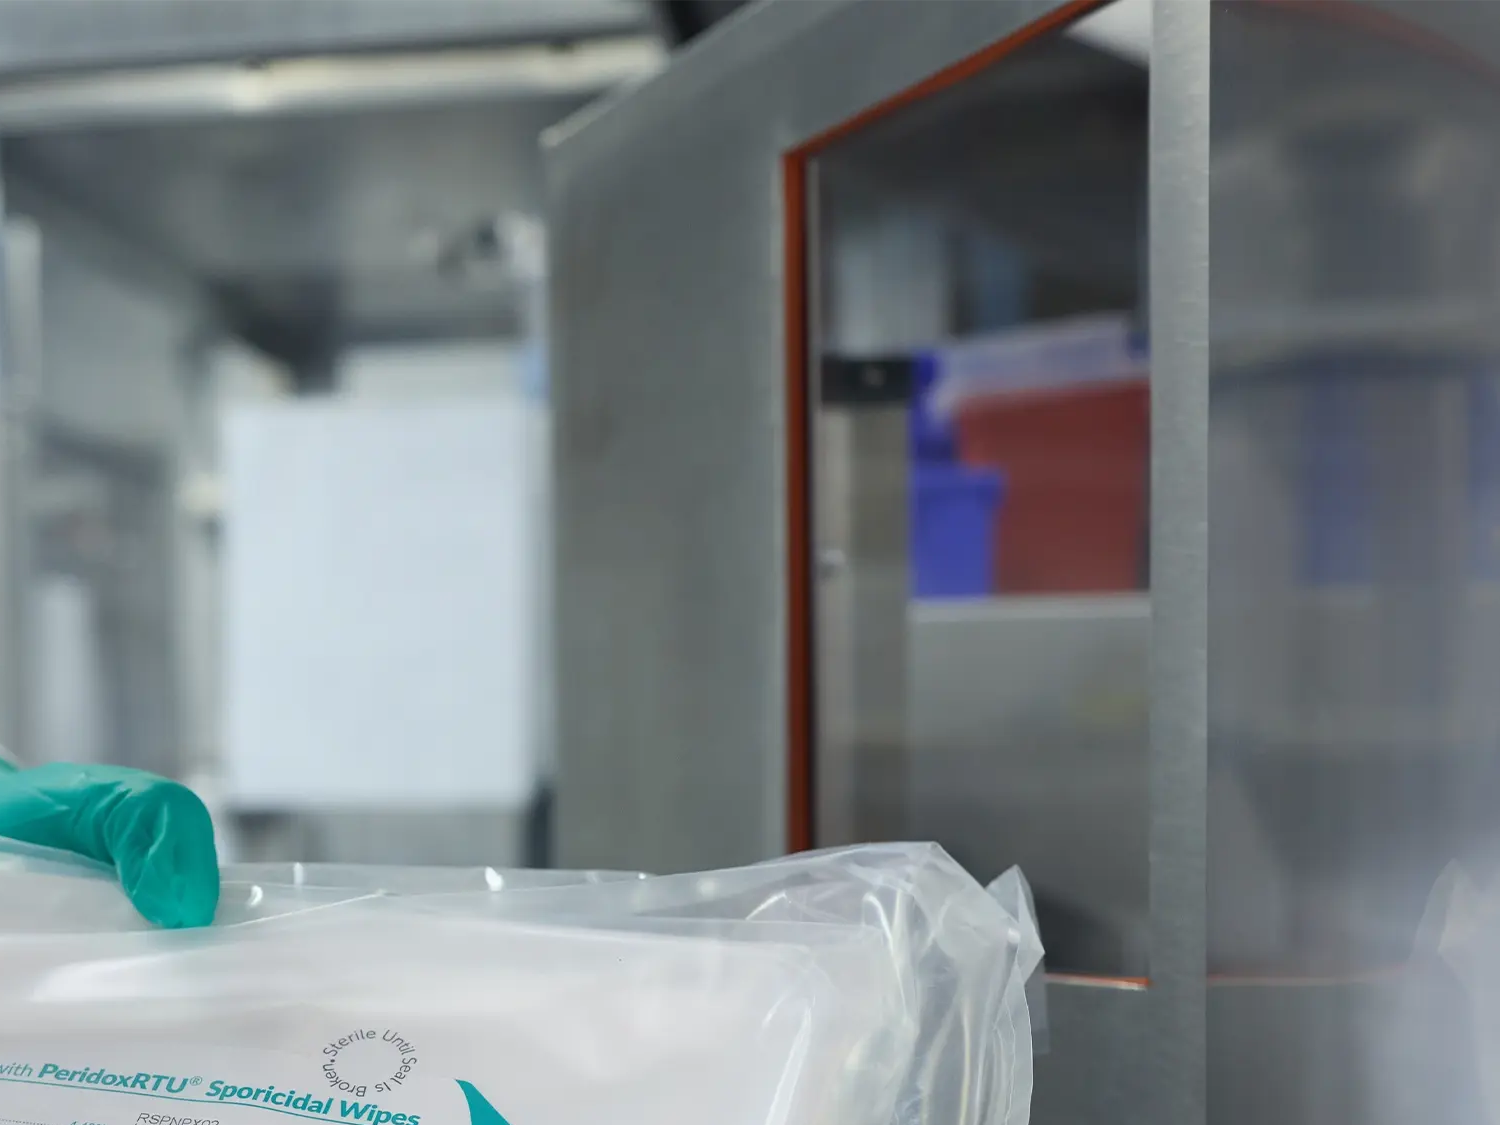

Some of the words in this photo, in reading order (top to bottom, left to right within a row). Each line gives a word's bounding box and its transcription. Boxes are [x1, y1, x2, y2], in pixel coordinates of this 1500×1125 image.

[323, 1029, 376, 1056] Sterile
[383, 1030, 415, 1055] Until
[390, 1057, 417, 1085] Seal
[206, 1080, 334, 1114] Sporicidal
[375, 1082, 391, 1092] Is
